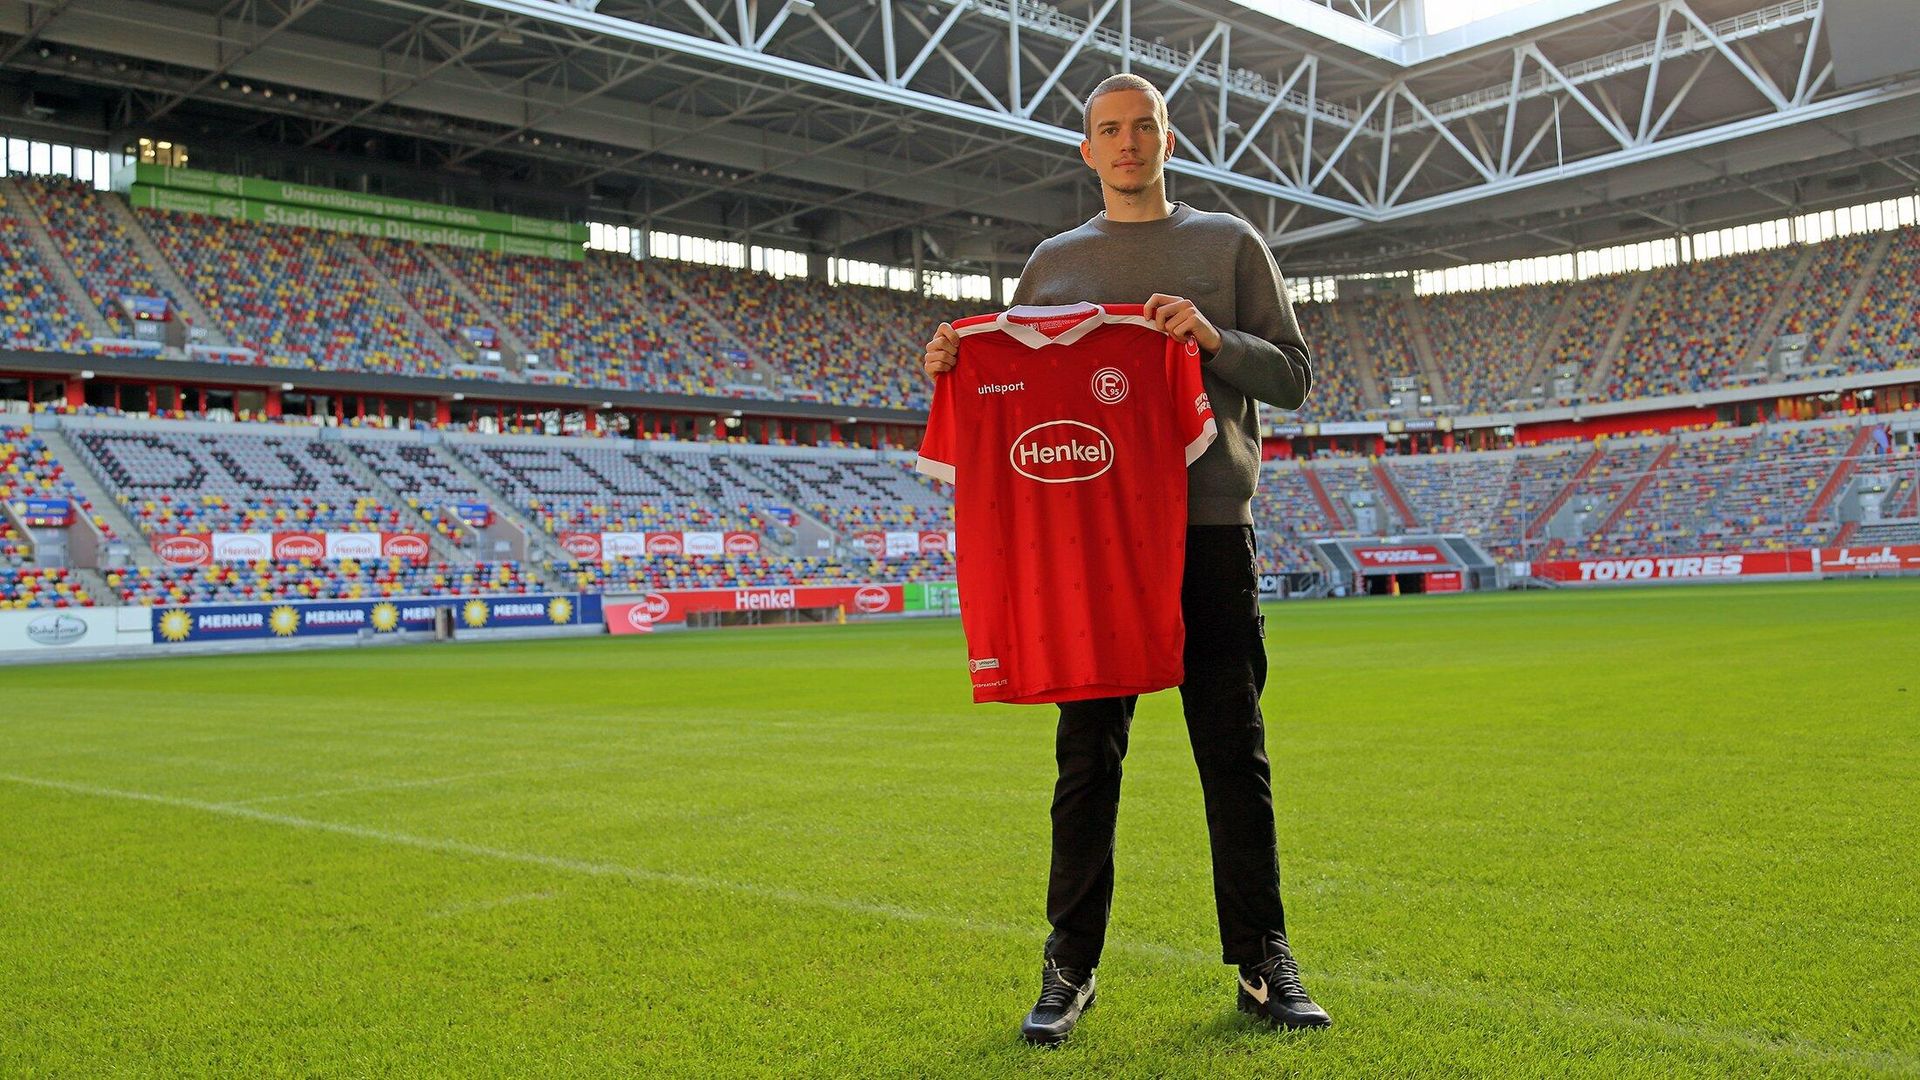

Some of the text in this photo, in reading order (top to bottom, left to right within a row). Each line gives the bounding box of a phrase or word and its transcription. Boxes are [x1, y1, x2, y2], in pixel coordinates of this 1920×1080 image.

[264, 204, 381, 236] Stadtwerke
[978, 381, 1024, 395] uhlsport
[1020, 439, 1106, 466] Henkel
[1579, 555, 1744, 580] TOYO TIRES
[735, 589, 795, 609] Henkel
[305, 609, 365, 624] MERKUR
[493, 603, 545, 617] MERKUR
[199, 613, 264, 628] MERKUR
